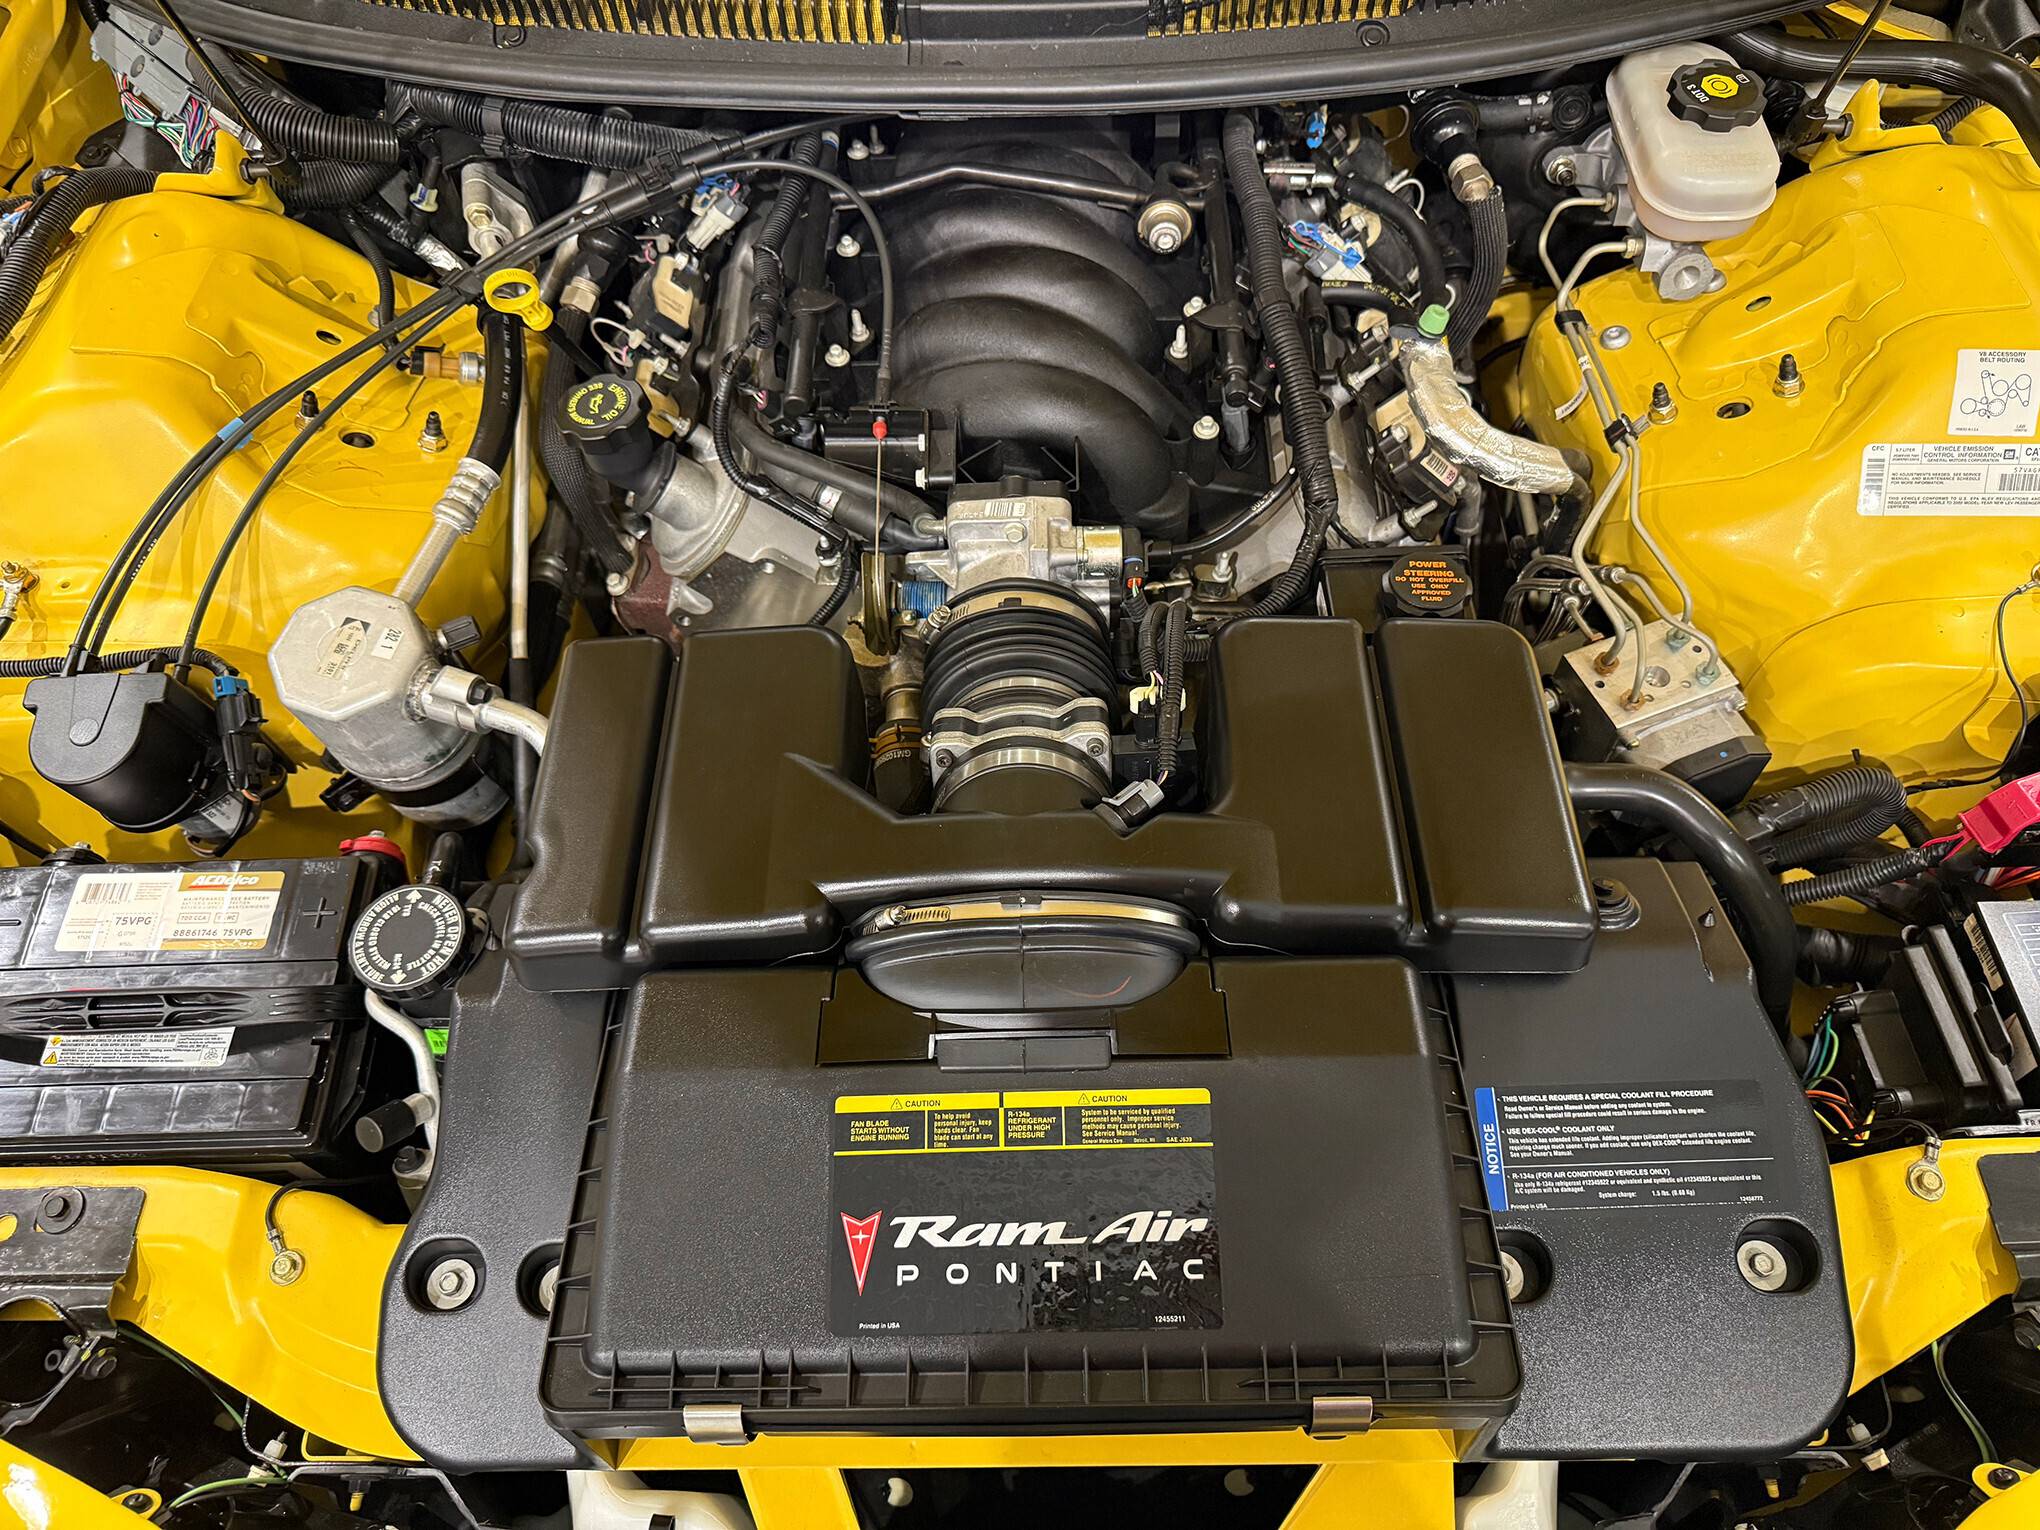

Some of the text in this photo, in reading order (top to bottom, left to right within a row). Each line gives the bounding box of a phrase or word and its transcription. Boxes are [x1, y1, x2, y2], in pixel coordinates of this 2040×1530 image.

[1690, 88, 1709, 103] DOT
[601, 384, 627, 421] ENGINE OIL
[192, 876, 259, 885] ACDelco
[374, 894, 399, 913] ALIGN
[432, 895, 458, 924] NEVER
[115, 917, 152, 925] 75VPG
[356, 912, 377, 940] ARROW
[368, 919, 386, 946] CLOSED
[407, 902, 446, 970] CHECK LEVEL IN BOTTLE
[439, 926, 459, 956] OPEN
[356, 947, 369, 967] VENT
[369, 947, 391, 969] SYSTEM
[421, 956, 444, 976] HOT
[364, 964, 385, 982] TUBE
[934, 1120, 958, 1128] personal
[1484, 1123, 1500, 1175] NOTICE
[889, 1211, 1209, 1248] Ram Air
[897, 1259, 1205, 1286] PONTIAC
